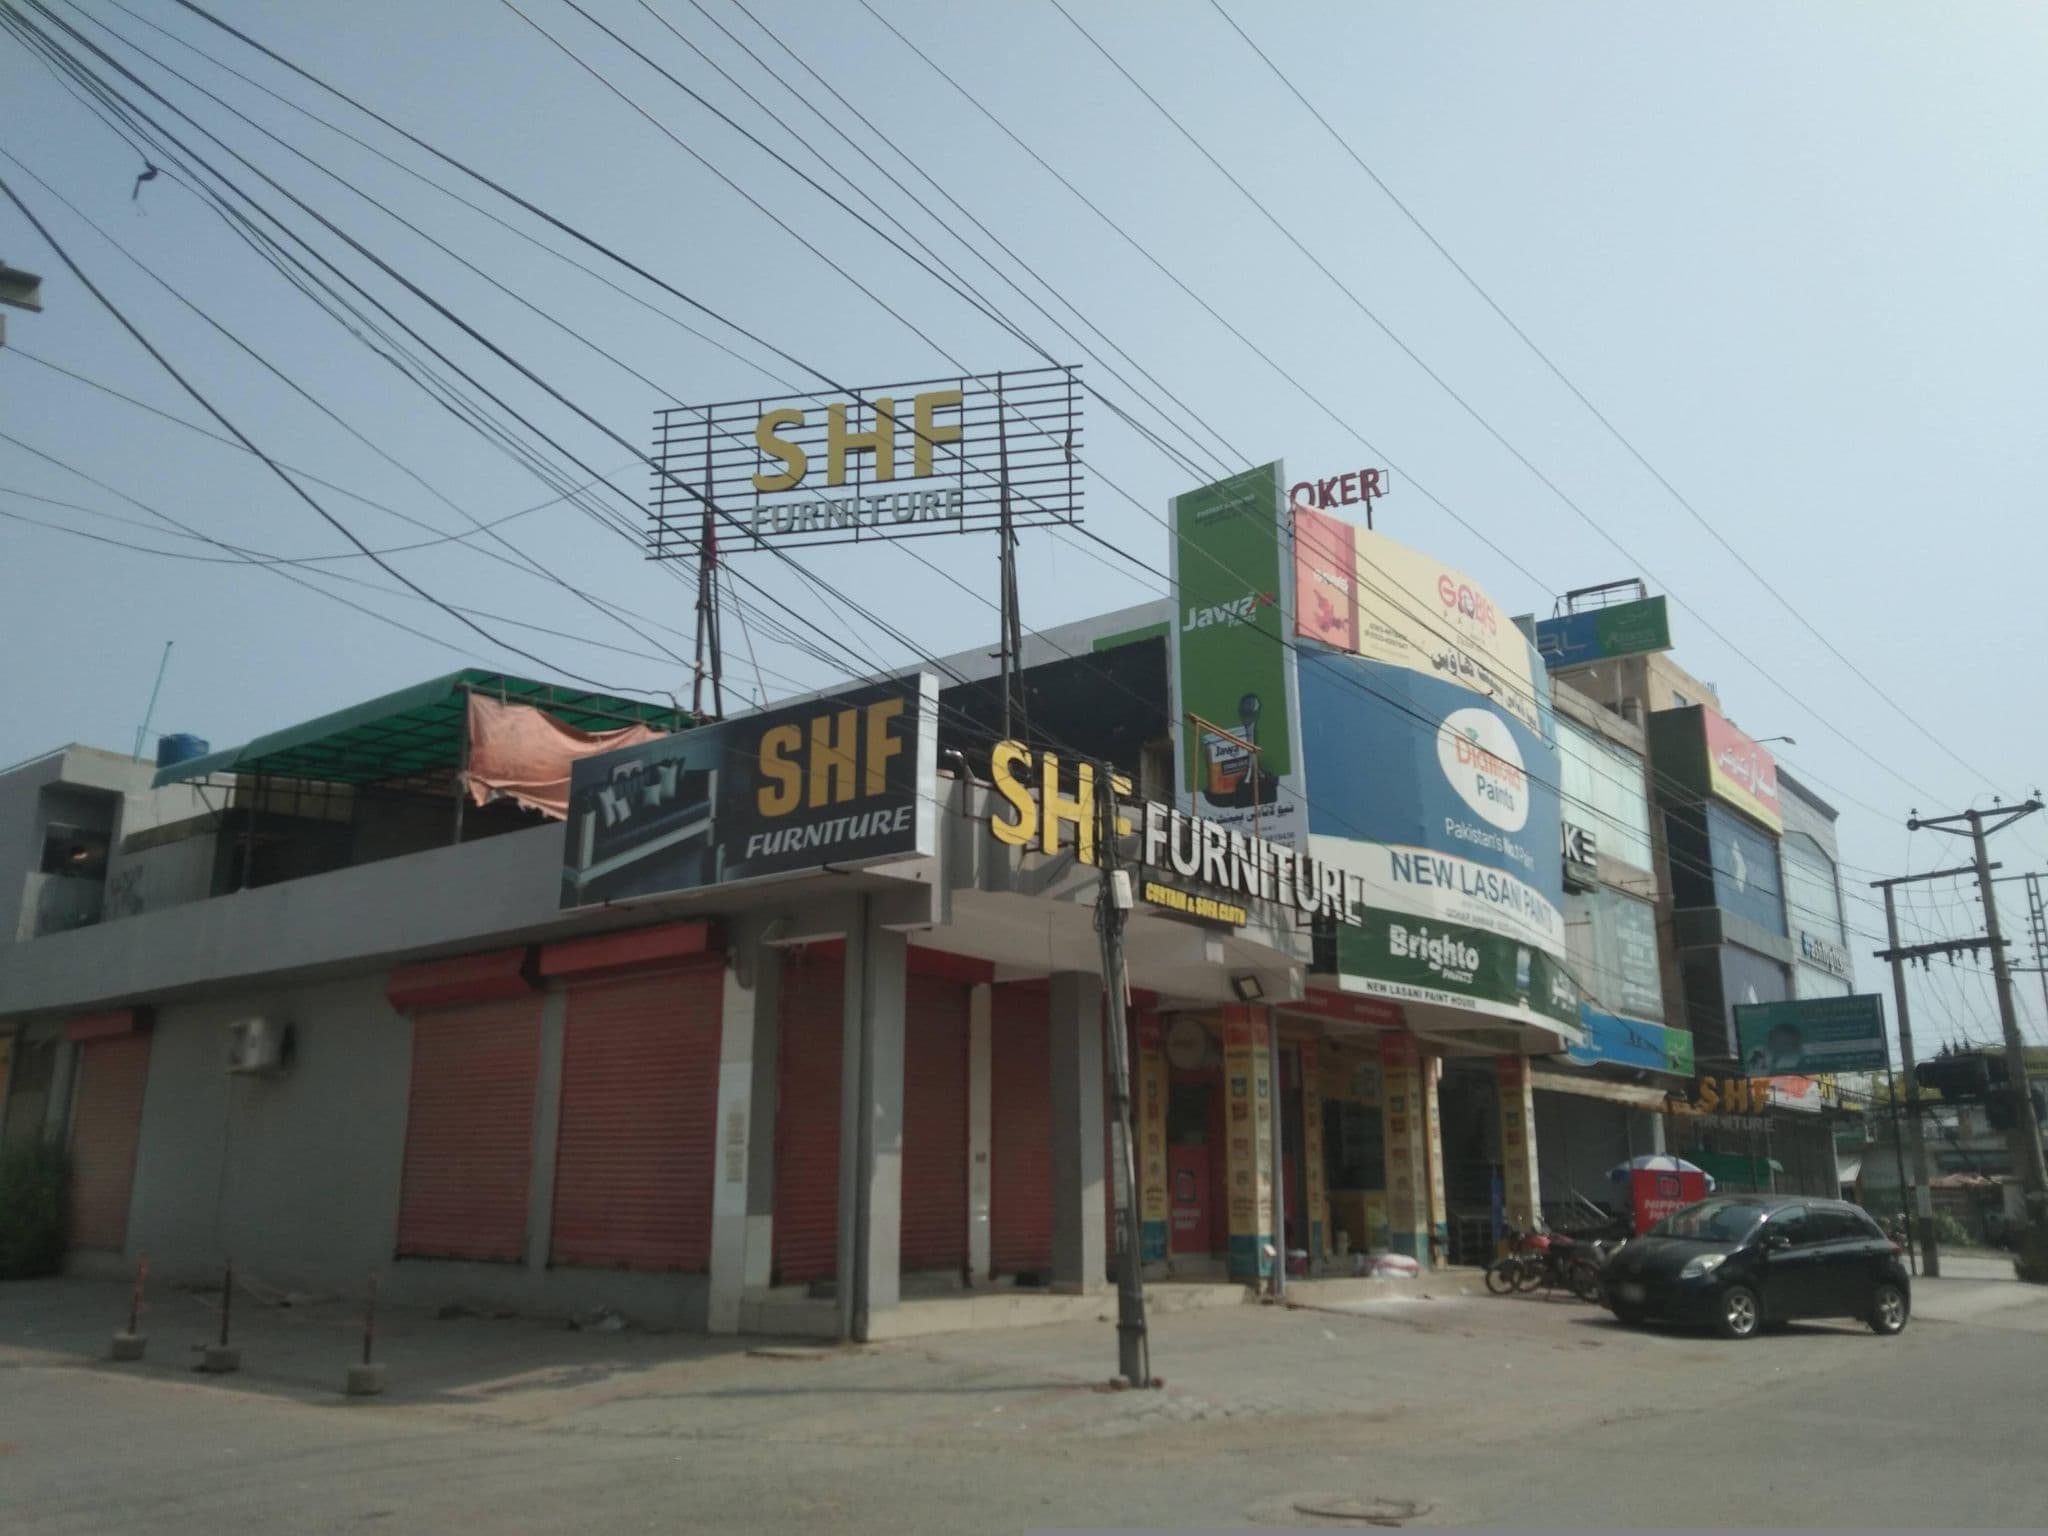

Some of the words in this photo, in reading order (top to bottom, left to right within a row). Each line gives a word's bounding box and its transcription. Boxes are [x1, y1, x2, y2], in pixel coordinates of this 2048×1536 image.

[752, 390, 964, 493] SHF
[751, 488, 965, 535] FURNITURE
[757, 697, 905, 818] SHF
[1476, 774, 1515, 812] Paints
[746, 804, 914, 859] FURNITURE
[1390, 851, 1454, 890] NEW
[1389, 923, 1480, 971] Brighto
[1366, 981, 1387, 993] NEW
[1389, 985, 1422, 999] LASANI
[1424, 991, 1449, 1003] PAINT
[1699, 1076, 1771, 1113] SHF
